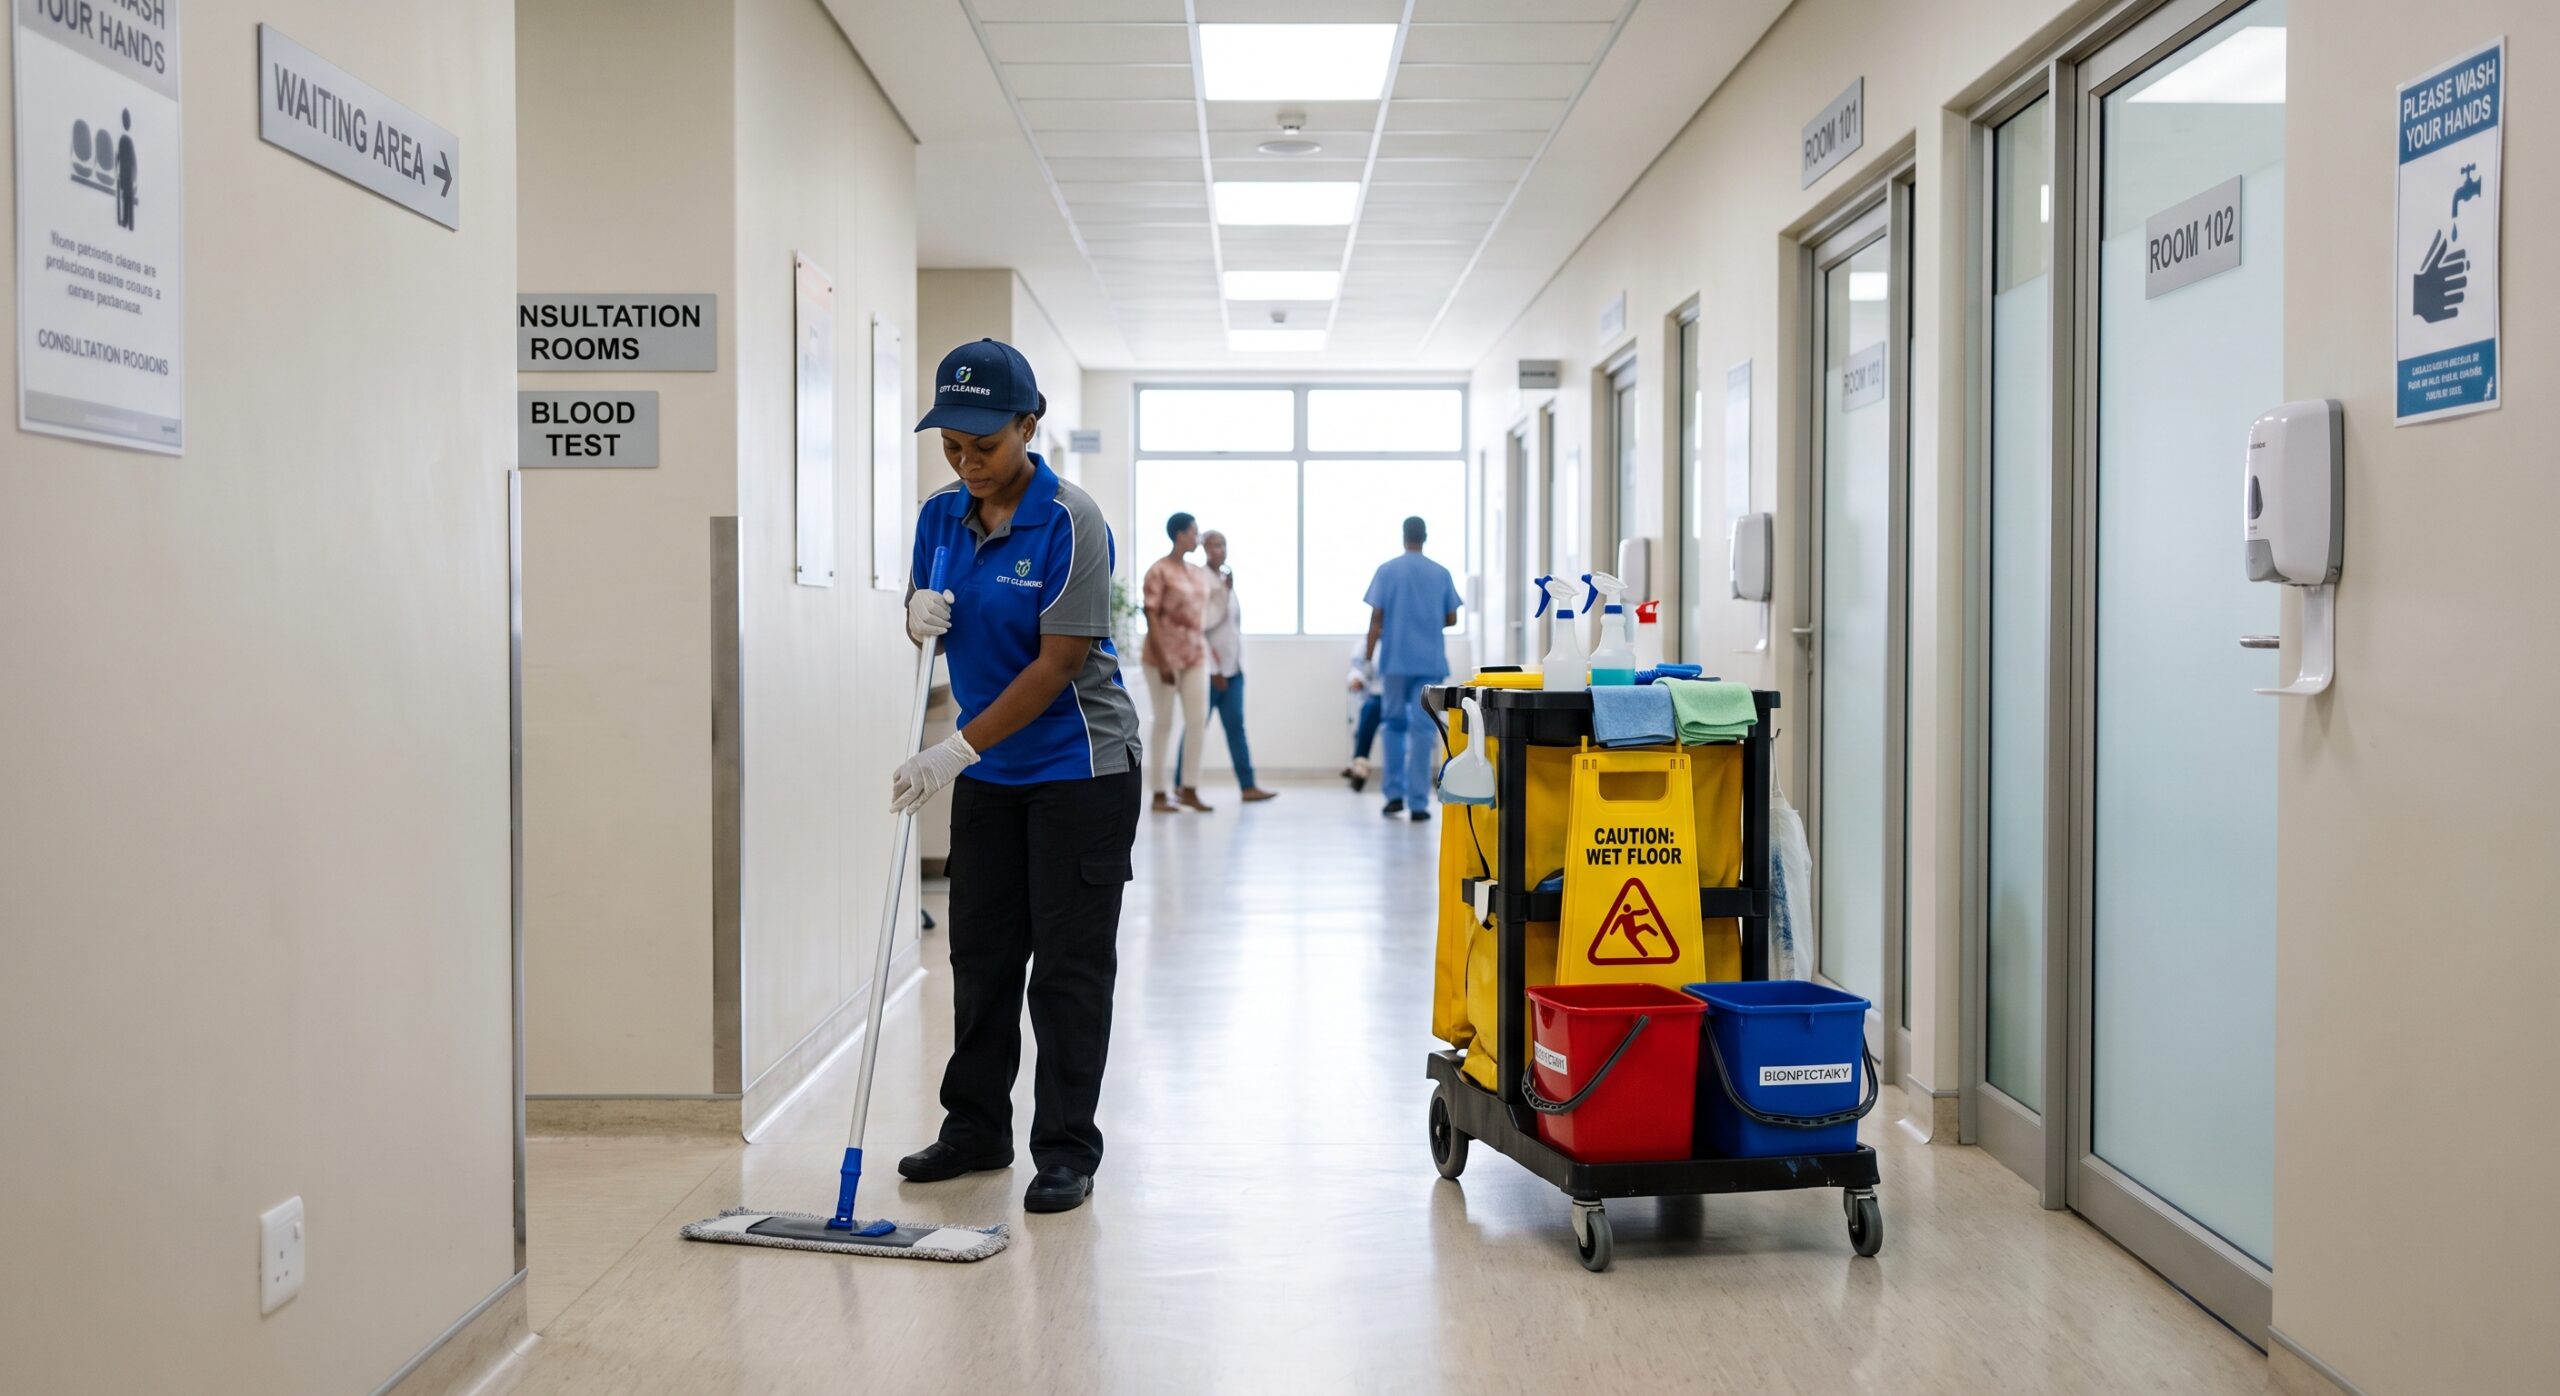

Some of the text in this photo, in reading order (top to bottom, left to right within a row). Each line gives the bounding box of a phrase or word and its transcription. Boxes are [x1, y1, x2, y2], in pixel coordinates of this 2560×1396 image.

[100, 11, 165, 74] HANDS
[2403, 58, 2496, 123] PLEASE WASH
[274, 63, 426, 186] WAITING AREA
[1804, 99, 1857, 171] ROOM 101
[2406, 94, 2491, 152] YOUR HANDS
[2150, 205, 2234, 274] ROOM 102
[520, 305, 701, 328] NSULTATION
[38, 328, 121, 365] CONSULTATION
[531, 337, 640, 360] ROOMS
[951, 384, 991, 396] CLEANERS
[531, 401, 636, 424] BLOOD
[546, 433, 621, 456] TEST
[1594, 827, 1675, 845] CAUTION:
[1586, 847, 1682, 865] WET FLOOR
